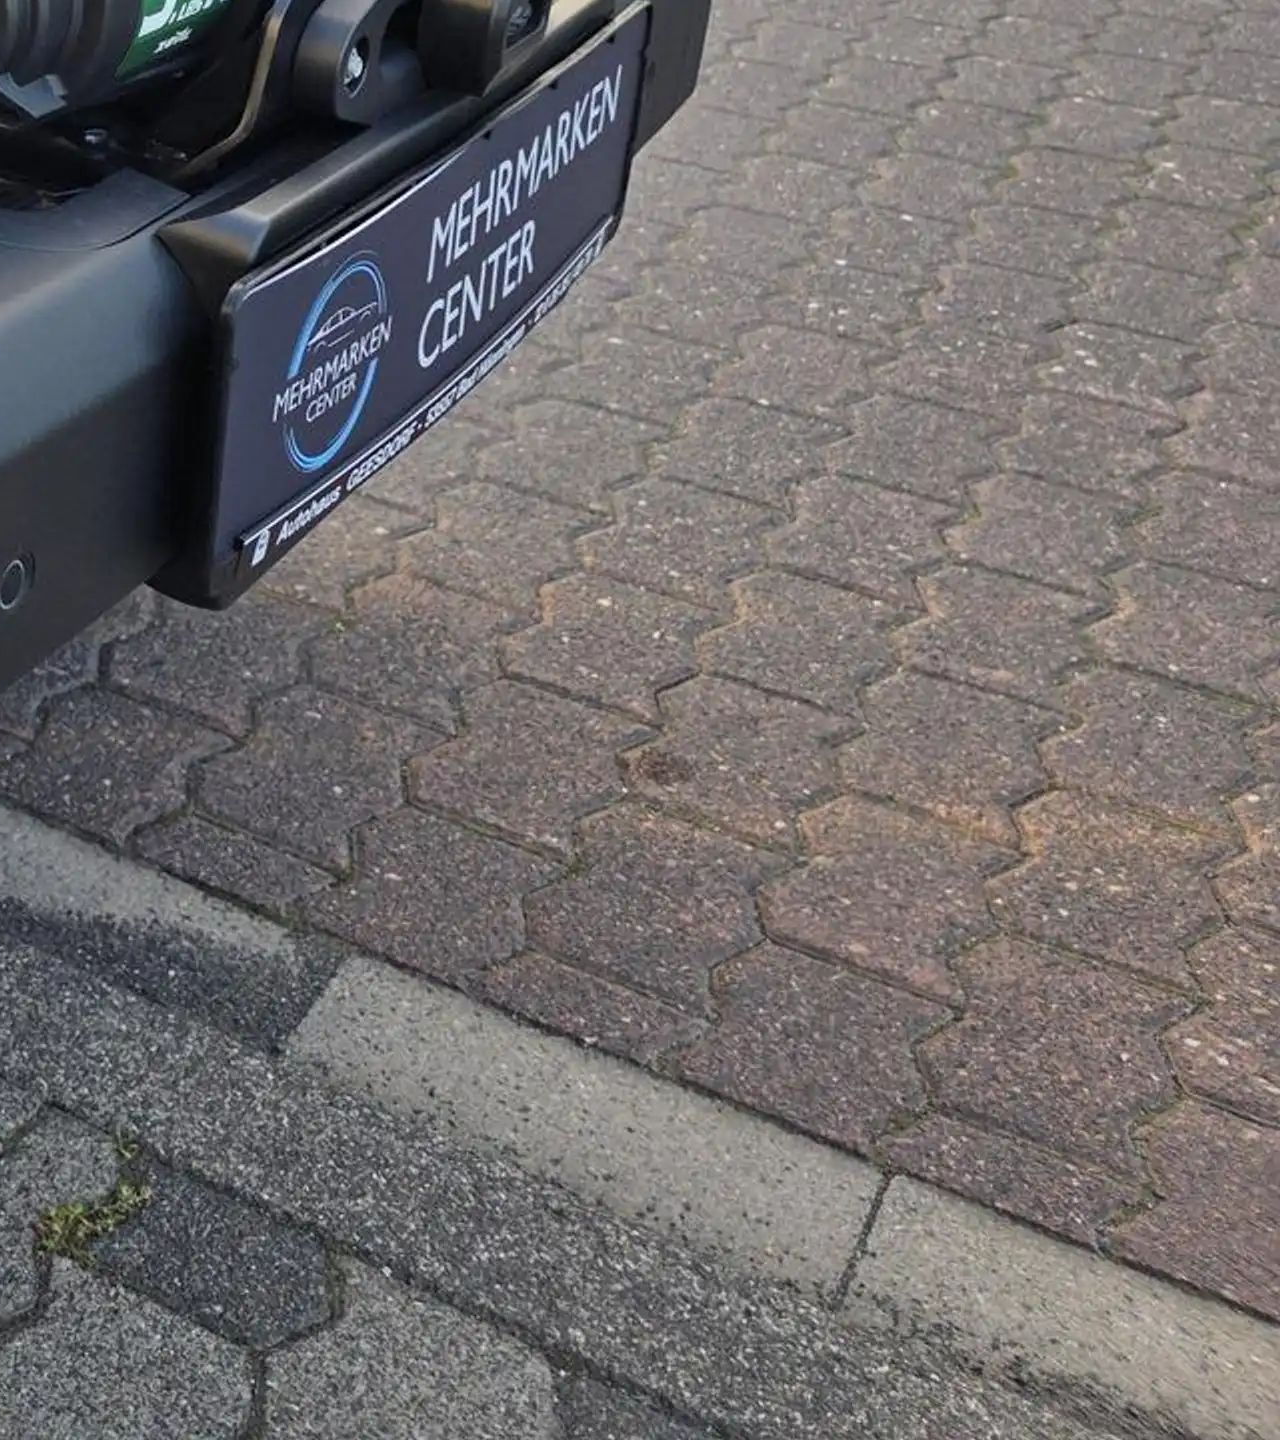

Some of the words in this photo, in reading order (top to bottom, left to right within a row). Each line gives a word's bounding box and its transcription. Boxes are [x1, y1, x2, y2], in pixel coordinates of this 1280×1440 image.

[426, 63, 623, 283] MEHRMARKEN
[418, 219, 536, 368] CENTER
[272, 315, 393, 423] MEHRMARKEN
[305, 371, 357, 423] CENTER
[276, 486, 342, 545] Autohaus
